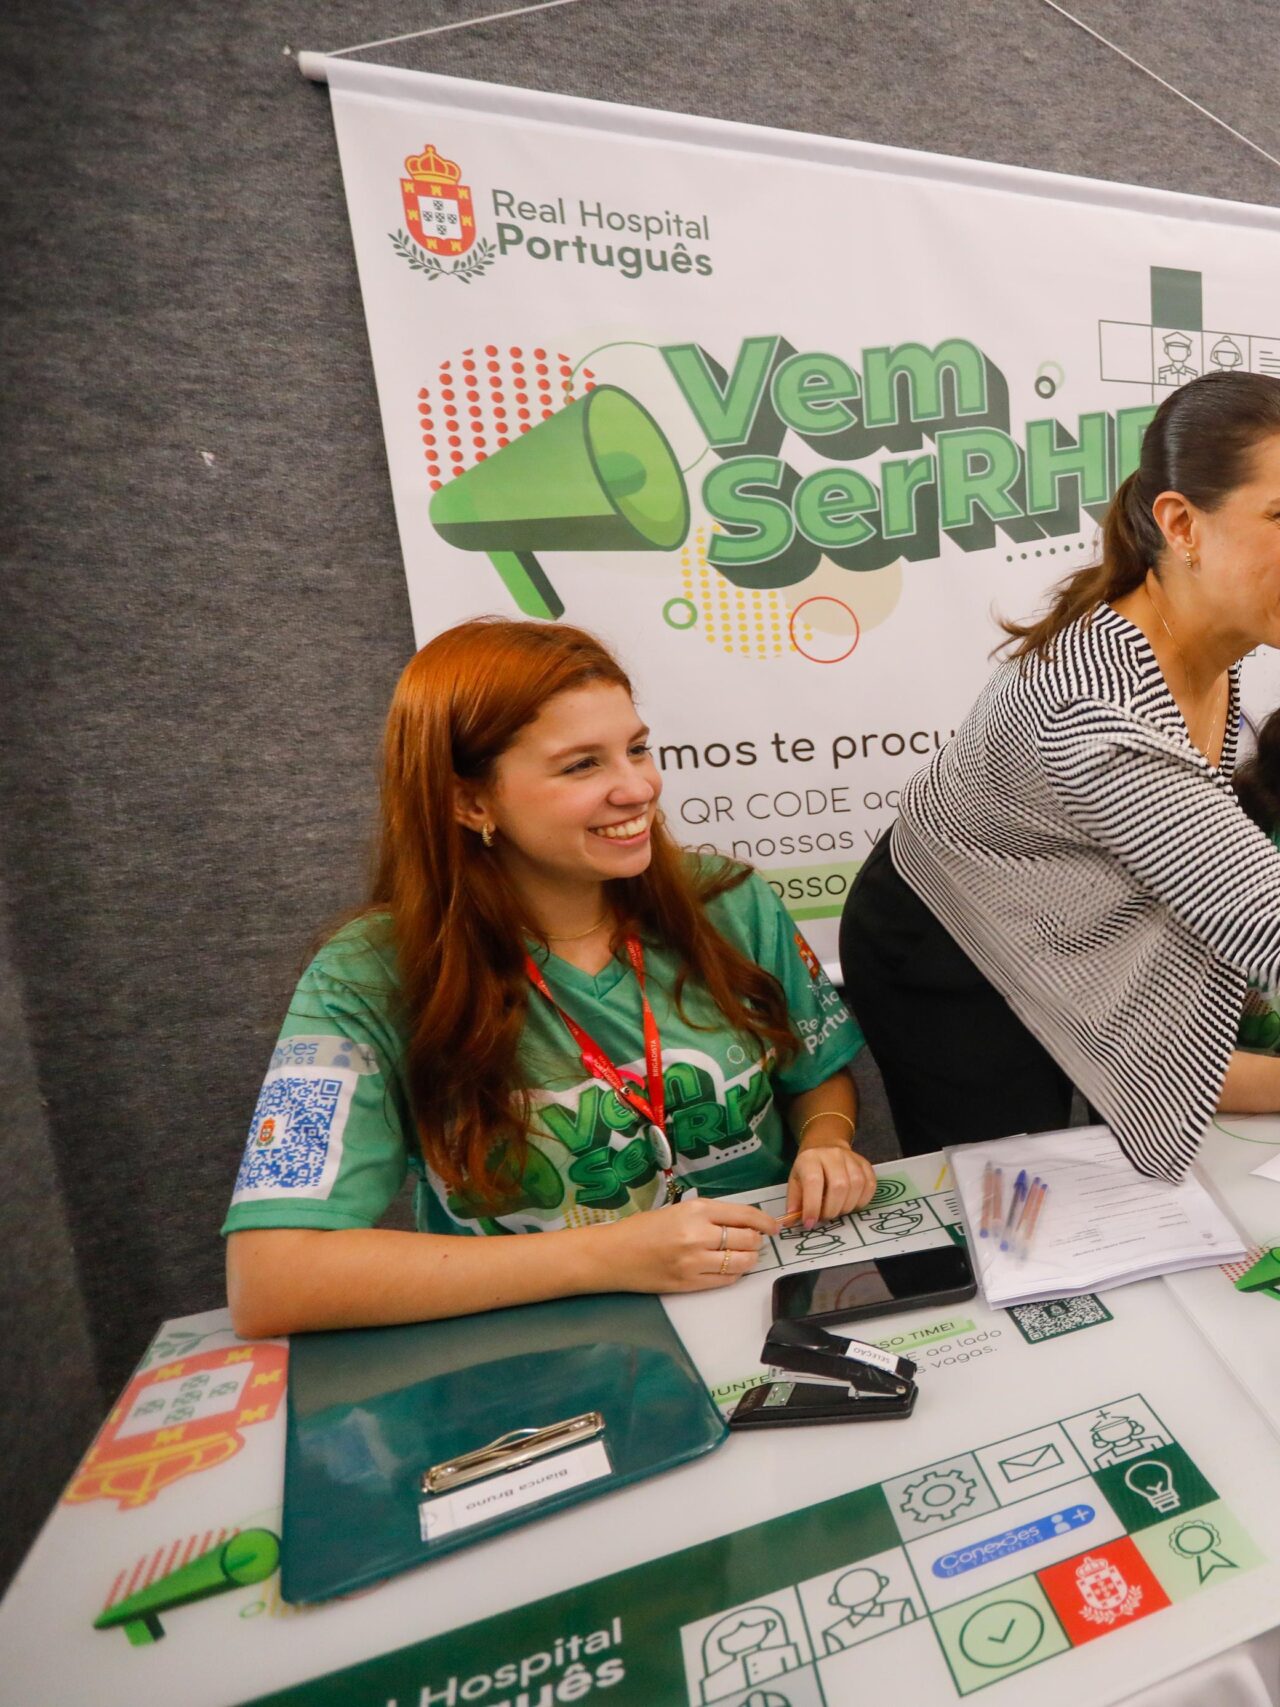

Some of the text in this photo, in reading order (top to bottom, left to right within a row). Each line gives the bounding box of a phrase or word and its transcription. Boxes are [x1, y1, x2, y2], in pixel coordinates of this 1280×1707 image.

[491, 188, 711, 241] Real Hospital
[496, 222, 714, 279] Português
[660, 334, 995, 450] Vem
[660, 740, 757, 770] mos
[772, 732, 815, 763] te
[680, 796, 735, 825] QR
[746, 786, 851, 820] CODE
[732, 829, 854, 858] nossas
[926, 1345, 952, 1357] ao
[957, 1330, 1002, 1348] lado
[931, 1345, 998, 1369] vagas.
[466, 1469, 568, 1510] Bianca Bruno
[940, 1526, 1041, 1570] Conexões
[420, 1616, 622, 1707] Hospital
